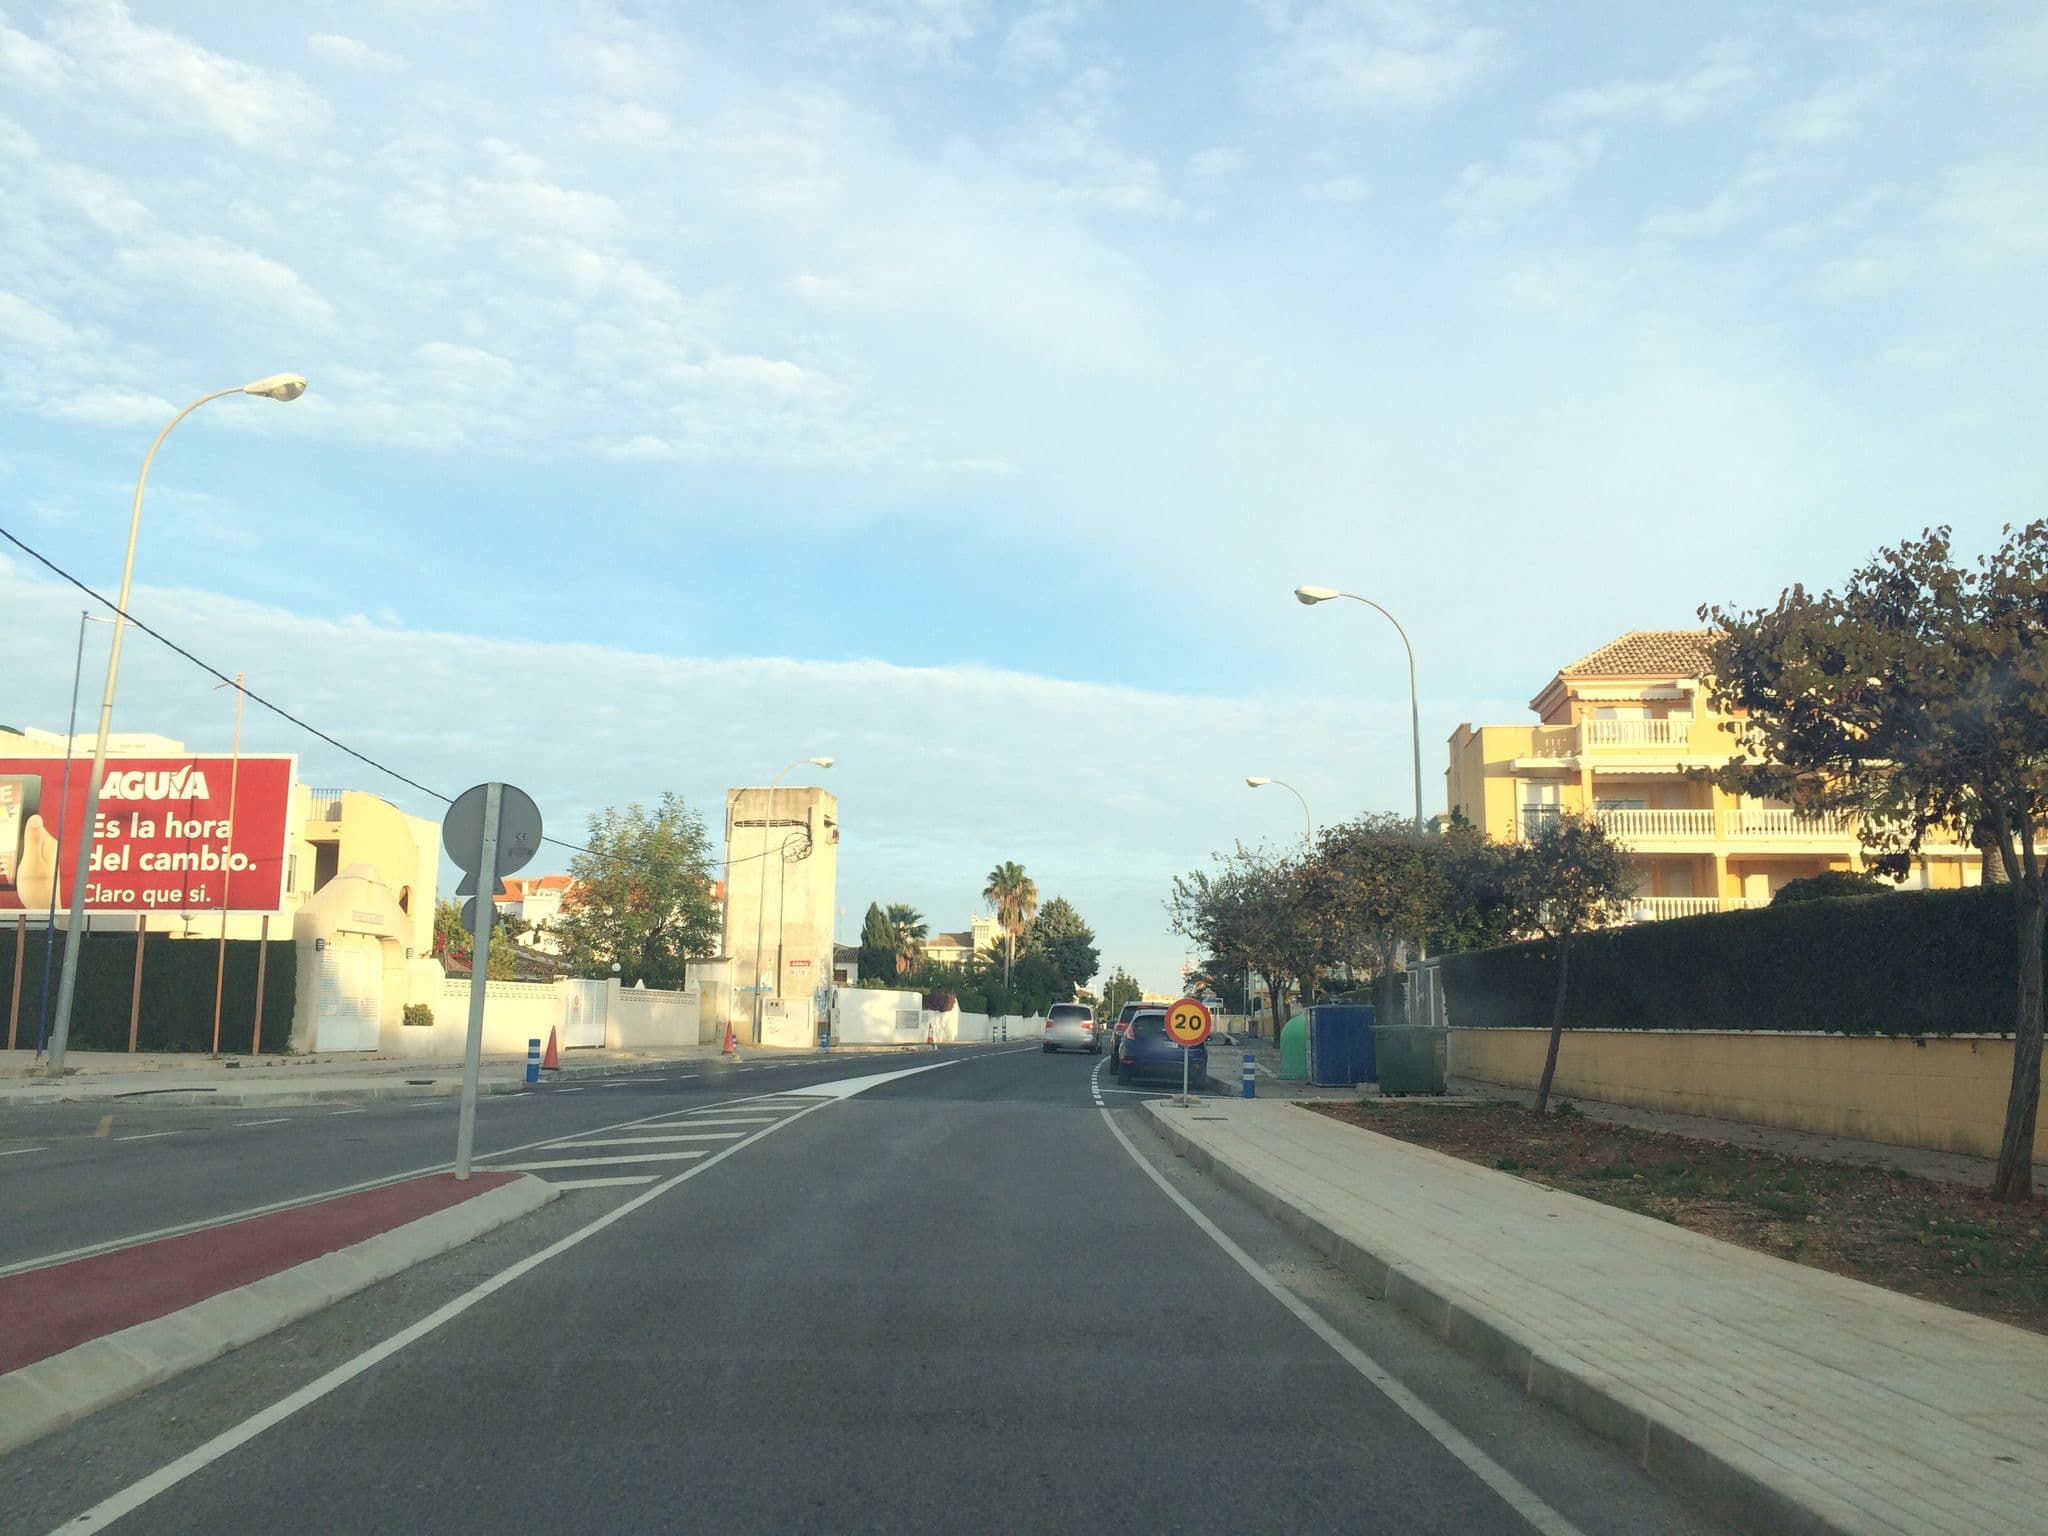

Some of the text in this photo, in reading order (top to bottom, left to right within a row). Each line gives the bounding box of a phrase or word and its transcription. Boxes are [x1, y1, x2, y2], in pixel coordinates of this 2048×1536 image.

[93, 811, 232, 839] Es la hora
[88, 844, 257, 871] del cambio.
[142, 888, 183, 908] que
[1175, 1013, 1202, 1030] 20
